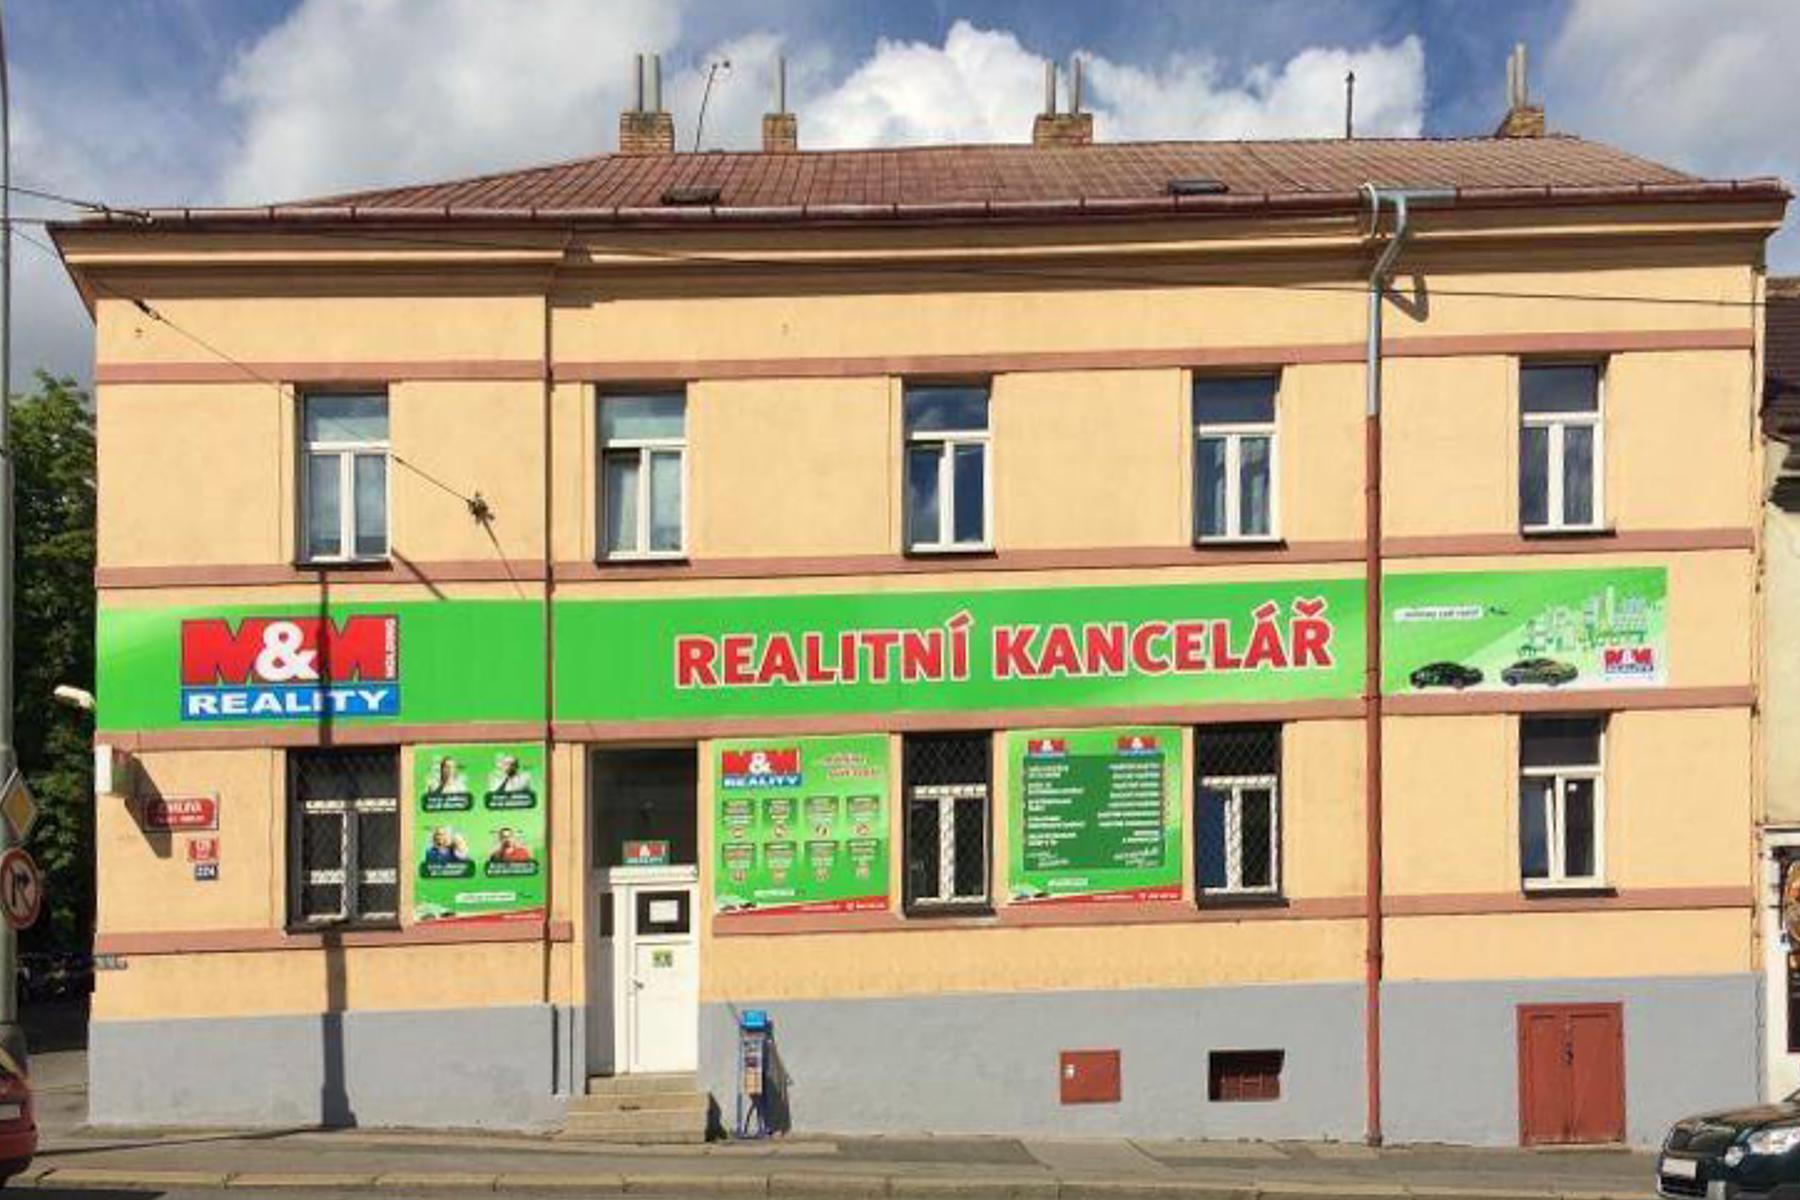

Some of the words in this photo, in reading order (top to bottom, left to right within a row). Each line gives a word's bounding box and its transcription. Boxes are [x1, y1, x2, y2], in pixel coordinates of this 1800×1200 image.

[181, 614, 386, 685] M&M
[674, 609, 974, 689] REALITNÍ
[993, 597, 1333, 680] KANCELÁŘ
[187, 690, 389, 715] REALITY
